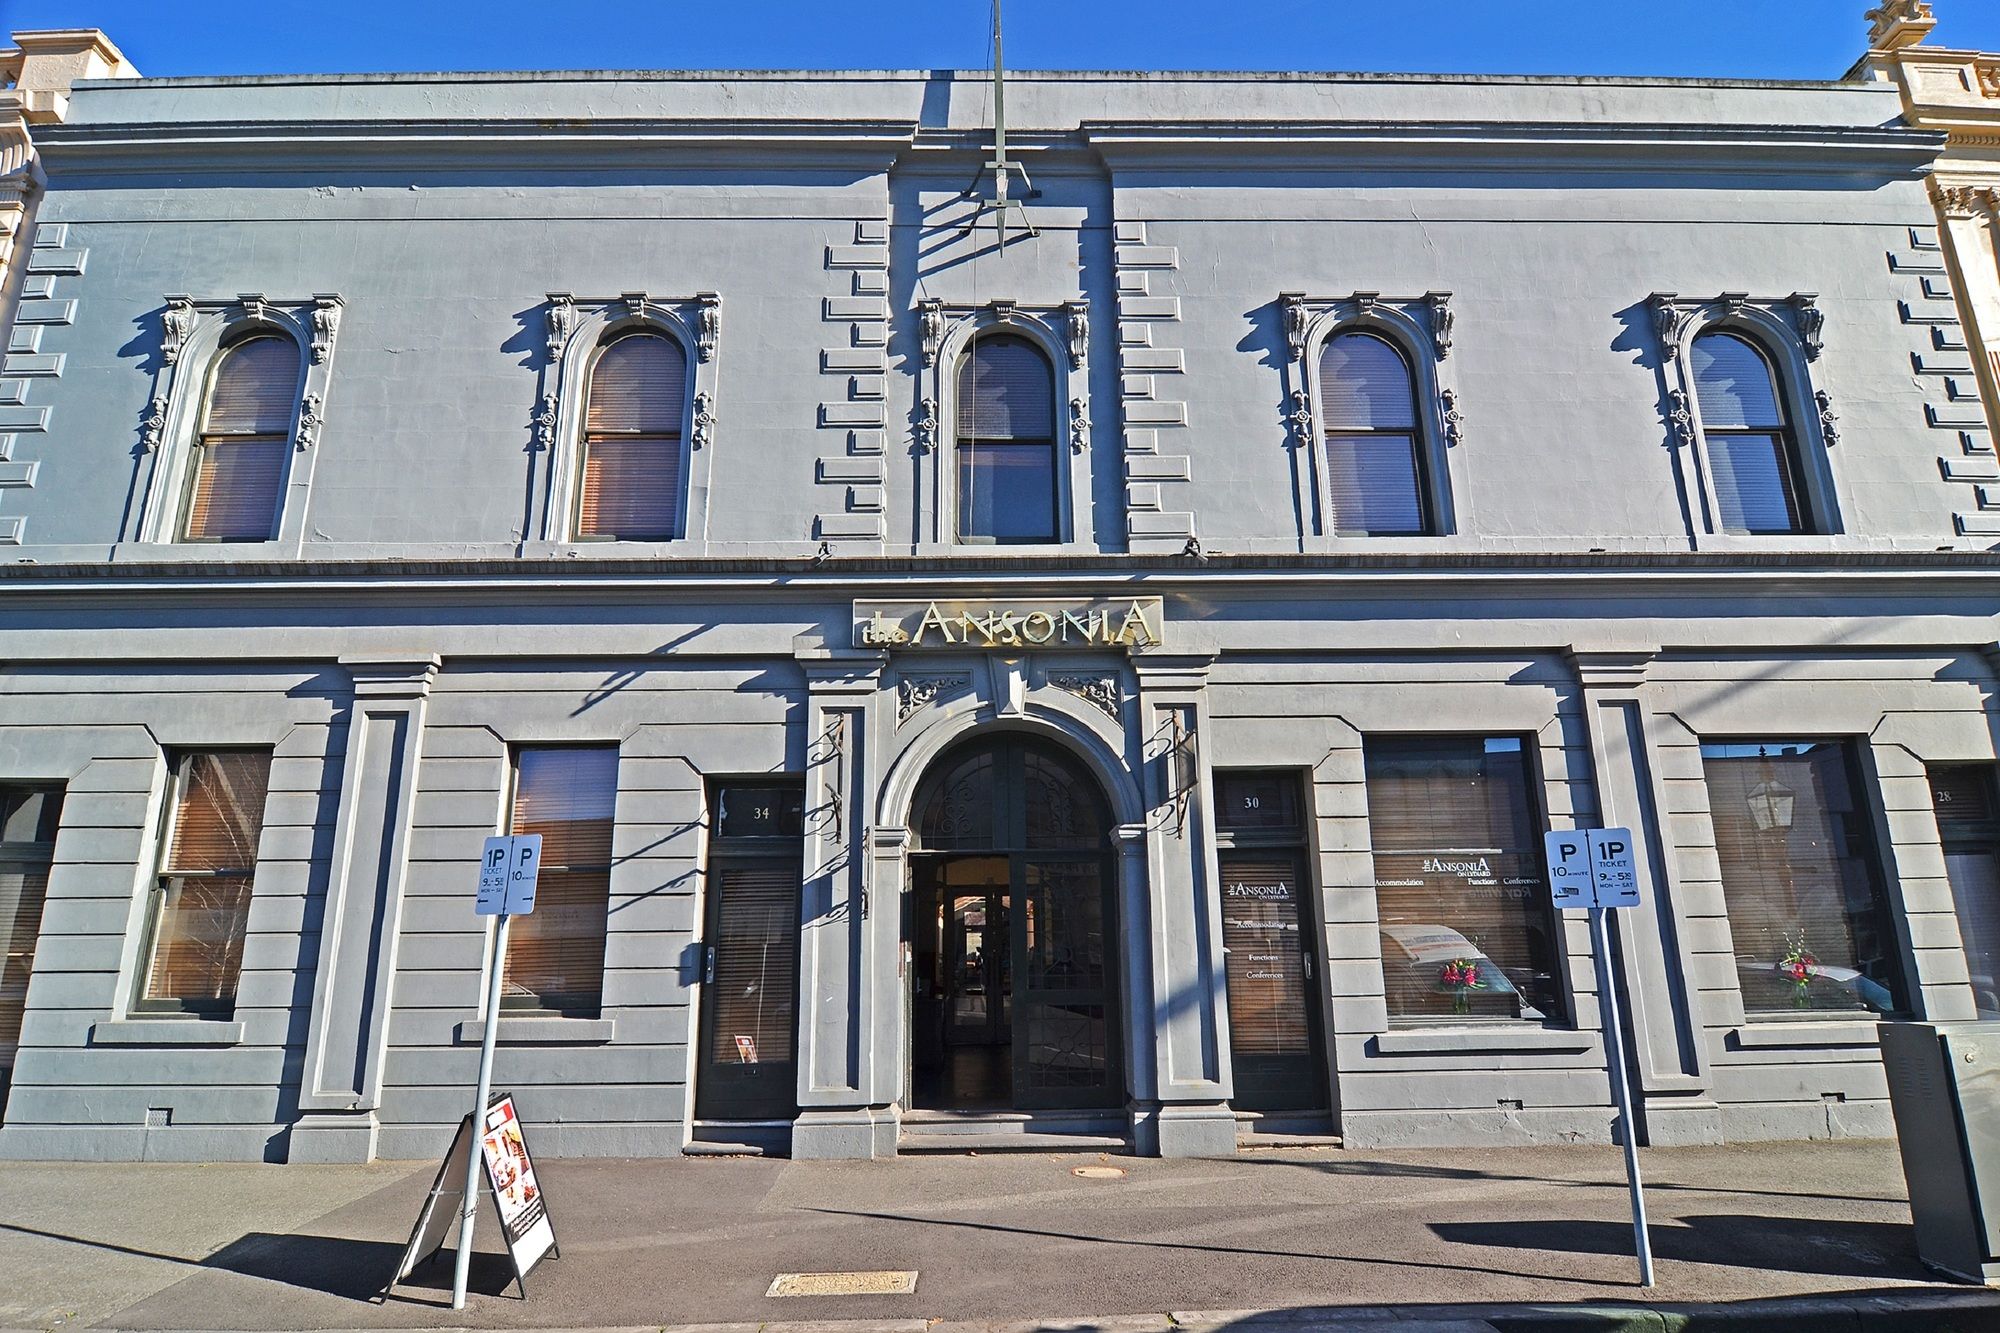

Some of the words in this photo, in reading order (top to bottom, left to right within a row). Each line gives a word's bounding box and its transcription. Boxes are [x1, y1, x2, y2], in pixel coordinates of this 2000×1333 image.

[862, 610, 904, 644] the
[910, 600, 1160, 645] ANSONIA
[1936, 790, 1952, 802] 28
[1244, 797, 1259, 809] 30
[754, 807, 770, 820] 34
[1559, 843, 1577, 863] P
[1598, 841, 1625, 860] 1P
[488, 848, 505, 867] 1P
[520, 848, 533, 867] P
[1431, 857, 1491, 872] ANSONIA
[1598, 860, 1627, 868] TICKET
[484, 867, 502, 875] TICKET
[512, 870, 522, 881] 10
[1551, 866, 1567, 877] 10
[1375, 877, 1425, 886] Accommodation
[1468, 877, 1497, 886] Functions
[1503, 877, 1541, 885] Conferences
[1235, 882, 1288, 896] ANSONIA
[1246, 970, 1284, 979] Conferences
